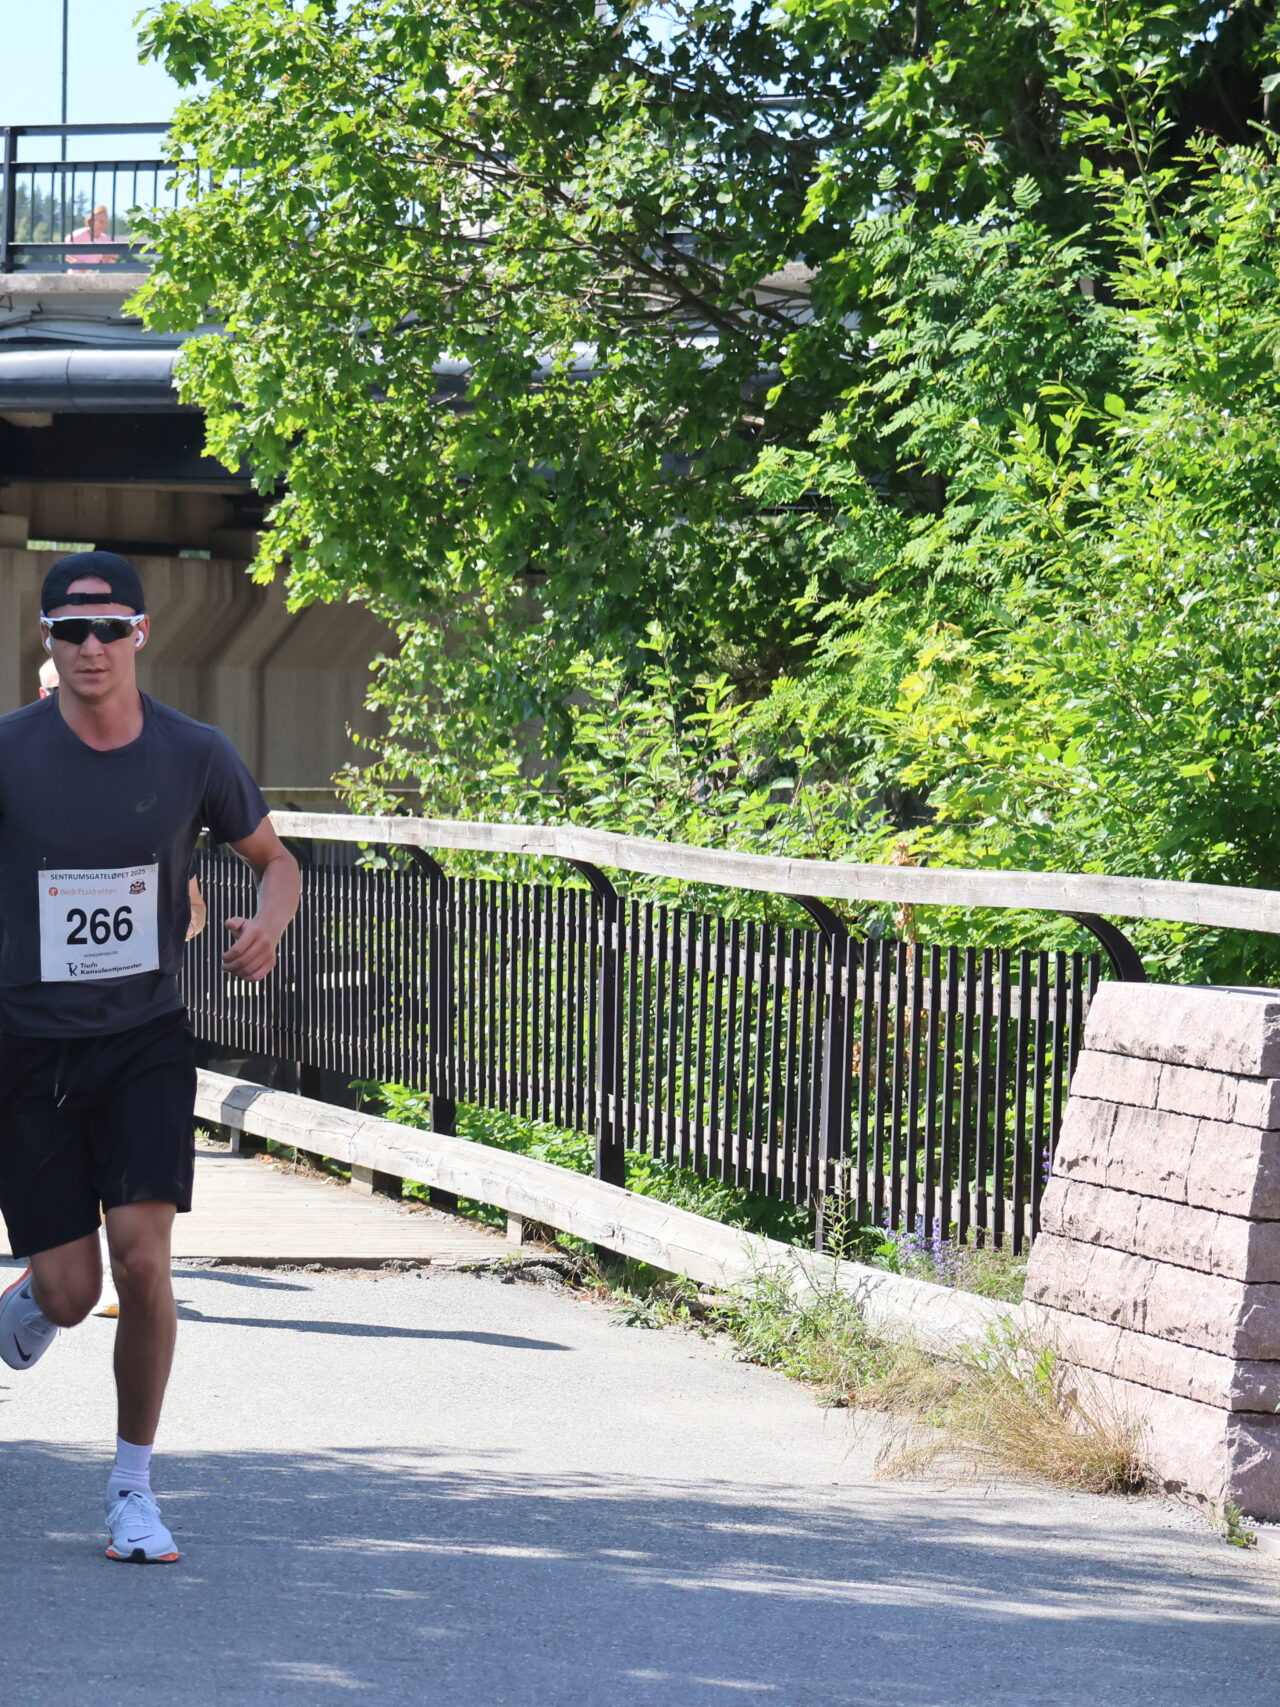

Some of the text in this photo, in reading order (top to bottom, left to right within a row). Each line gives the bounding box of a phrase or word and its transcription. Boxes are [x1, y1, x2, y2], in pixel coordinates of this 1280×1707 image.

[50, 869, 146, 880] SENTRUMSGATELØPET 2025
[67, 906, 133, 945] 266
